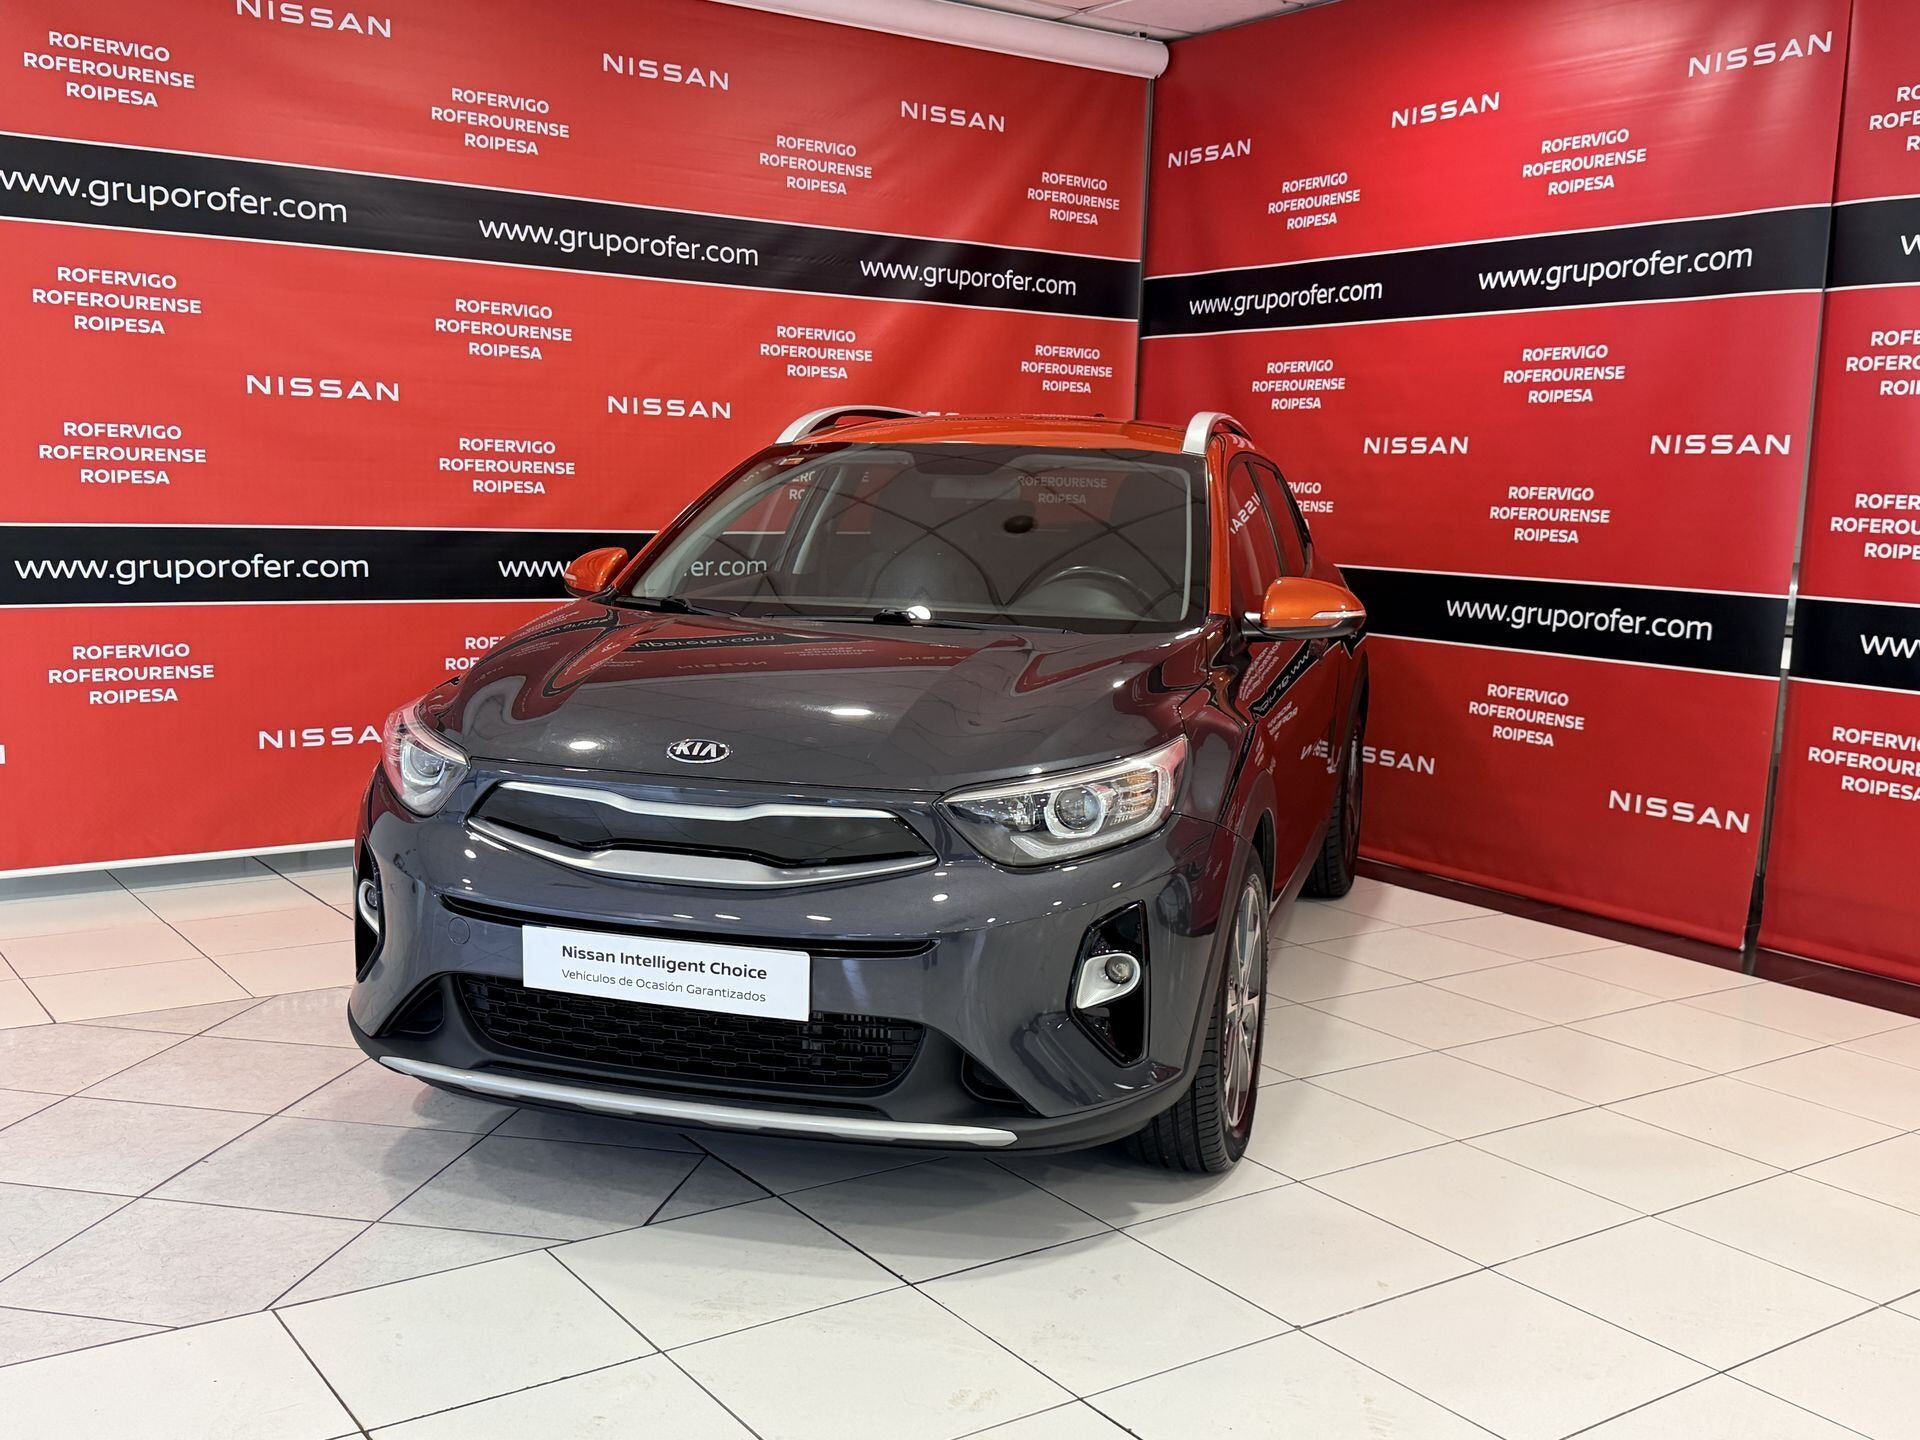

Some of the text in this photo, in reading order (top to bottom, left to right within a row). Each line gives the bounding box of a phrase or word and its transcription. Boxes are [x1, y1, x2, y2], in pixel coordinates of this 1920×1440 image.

[237, 0, 390, 38] NISSAN
[49, 31, 169, 61] ROFERVIGO
[1689, 32, 1832, 77] NISSAN
[24, 52, 194, 88] ROFEROURENSE
[604, 54, 728, 90] NISSAN
[67, 82, 158, 106] ROIPESA
[452, 88, 549, 113] ROFERVIGO
[902, 101, 1004, 132] NISSAN
[1392, 92, 1499, 128] NISSAN
[432, 107, 569, 138] ROFEROURENSE
[465, 133, 538, 155] ROIPESA
[777, 135, 856, 156] ROFERVIGO
[1542, 129, 1629, 154] ROFERVIGO
[1168, 139, 1250, 168] NISSAN
[1523, 148, 1646, 177] ROFEROURENSE
[760, 153, 872, 178] ROFEROURENSE
[787, 176, 846, 194] ROIPESA
[1042, 172, 1107, 190] ROFERVIGO
[1282, 172, 1347, 193] ROFERVIGO
[1548, 175, 1614, 195] ROIPESA
[1028, 188, 1119, 210] ROFEROURENSE
[1268, 189, 1360, 214] ROFEROURENSE
[1050, 209, 1098, 225] ROIPESA
[1287, 212, 1337, 229] ROIPESA
[479, 220, 758, 266] www.gruporofer.com
[58, 267, 176, 289] ROFERVIGO
[860, 261, 1076, 295] www.gruporofer.com
[1479, 248, 1752, 290] www.gruporofer.com
[33, 289, 201, 313] ROFEROURENSE
[456, 299, 552, 319] ROFERVIGO
[1190, 283, 1382, 316] www.gruporofer.com
[75, 316, 165, 334] ROIPESA
[436, 318, 572, 341] ROFEROURENSE
[777, 326, 856, 342] ROFERVIGO
[469, 342, 542, 359] ROIPESA
[761, 344, 872, 361] ROFEROURENSE
[1036, 345, 1100, 359] ROFERVIGO
[1523, 345, 1608, 361] ROFERVIGO
[788, 364, 848, 378] ROIPESA
[1022, 362, 1112, 377] ROFEROURENSE
[1267, 360, 1333, 373] ROFERVIGO
[1504, 366, 1625, 383] ROFEROURENSE
[247, 375, 398, 401] NISSAN
[1043, 380, 1091, 393] ROIPESA
[1252, 378, 1345, 392] ROFEROURENSE
[1272, 398, 1321, 409] ROIPESA
[1528, 389, 1592, 403] ROIPESA
[608, 396, 730, 418] NISSAN
[64, 422, 181, 439] ROFERVIGO
[40, 445, 206, 462] ROFEROURENSE
[460, 438, 555, 454] ROFERVIGO
[1364, 437, 1468, 454] NISSAN
[1650, 434, 1790, 454] NISSAN
[440, 458, 575, 474] ROFEROURENSE
[81, 469, 170, 484] ROIPESA
[473, 480, 545, 494] ROIPESA
[1508, 486, 1594, 500] ROFERVIGO
[1490, 507, 1610, 523] ROFEROURENSE
[1514, 528, 1578, 543] ROIPESA
[14, 554, 368, 585] www.gruporofer.com
[1447, 600, 1712, 640] www.gruporofer.com
[73, 644, 189, 660] ROFERVIGO
[49, 665, 214, 683] ROFEROURENSE
[90, 688, 178, 704] ROIPESA
[1488, 684, 1568, 706] ROFERVIGO
[1469, 702, 1584, 730] ROFEROURENSE
[1493, 726, 1554, 746] ROIPESA
[1832, 727, 1920, 751] ROFERVI
[676, 742, 718, 758] KIA
[1609, 790, 1749, 833] NISSAN
[562, 945, 767, 980] Nissan Intelligent Choice
[562, 968, 766, 1002] Vehículos de Ocasión Garantizados
